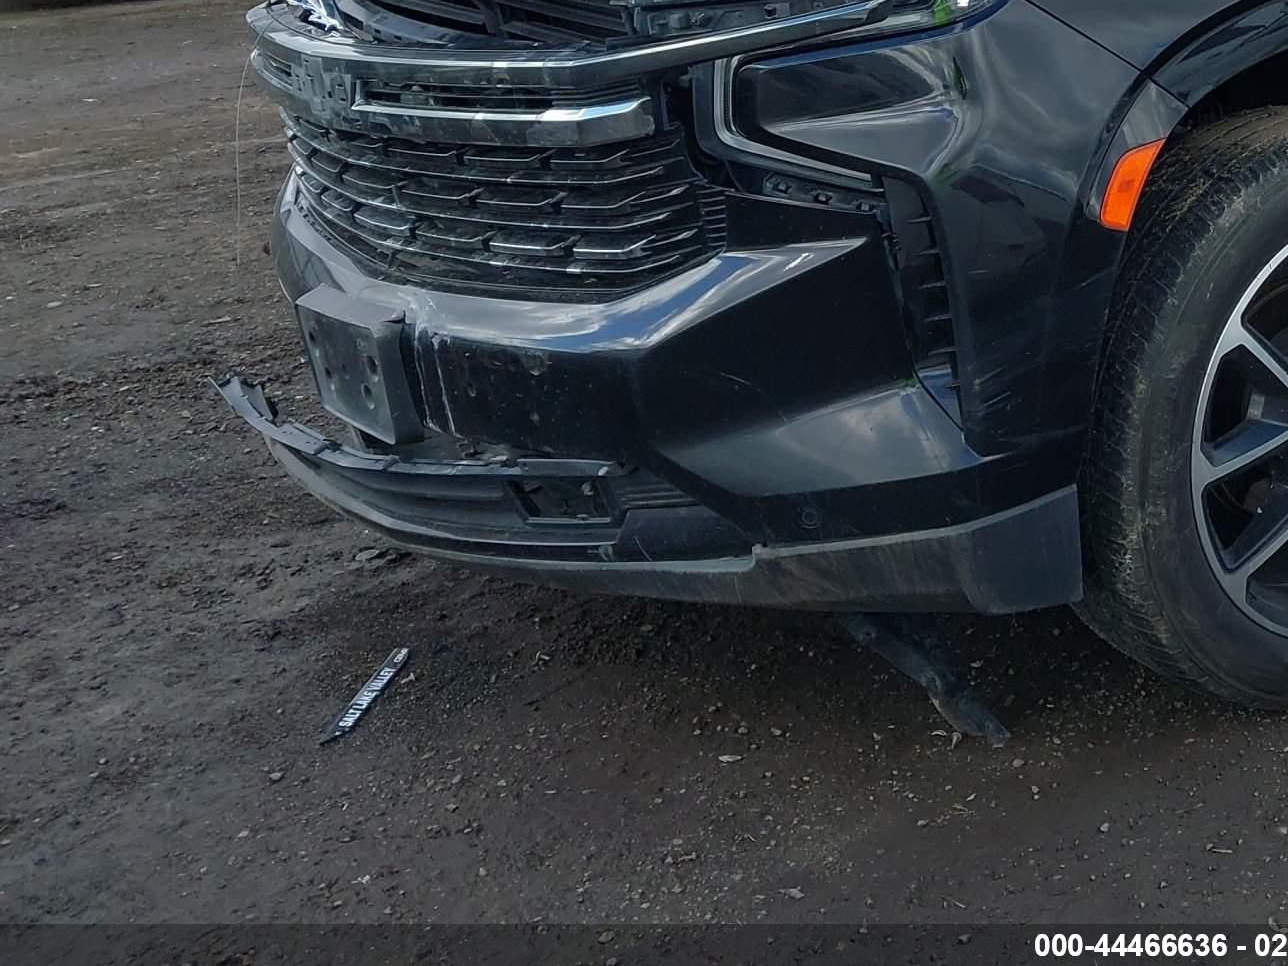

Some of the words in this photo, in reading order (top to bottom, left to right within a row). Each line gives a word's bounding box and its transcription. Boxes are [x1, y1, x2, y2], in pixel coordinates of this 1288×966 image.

[339, 708, 362, 726] SALT
[352, 690, 378, 710] LAKE
[368, 667, 397, 693] VALLEY
